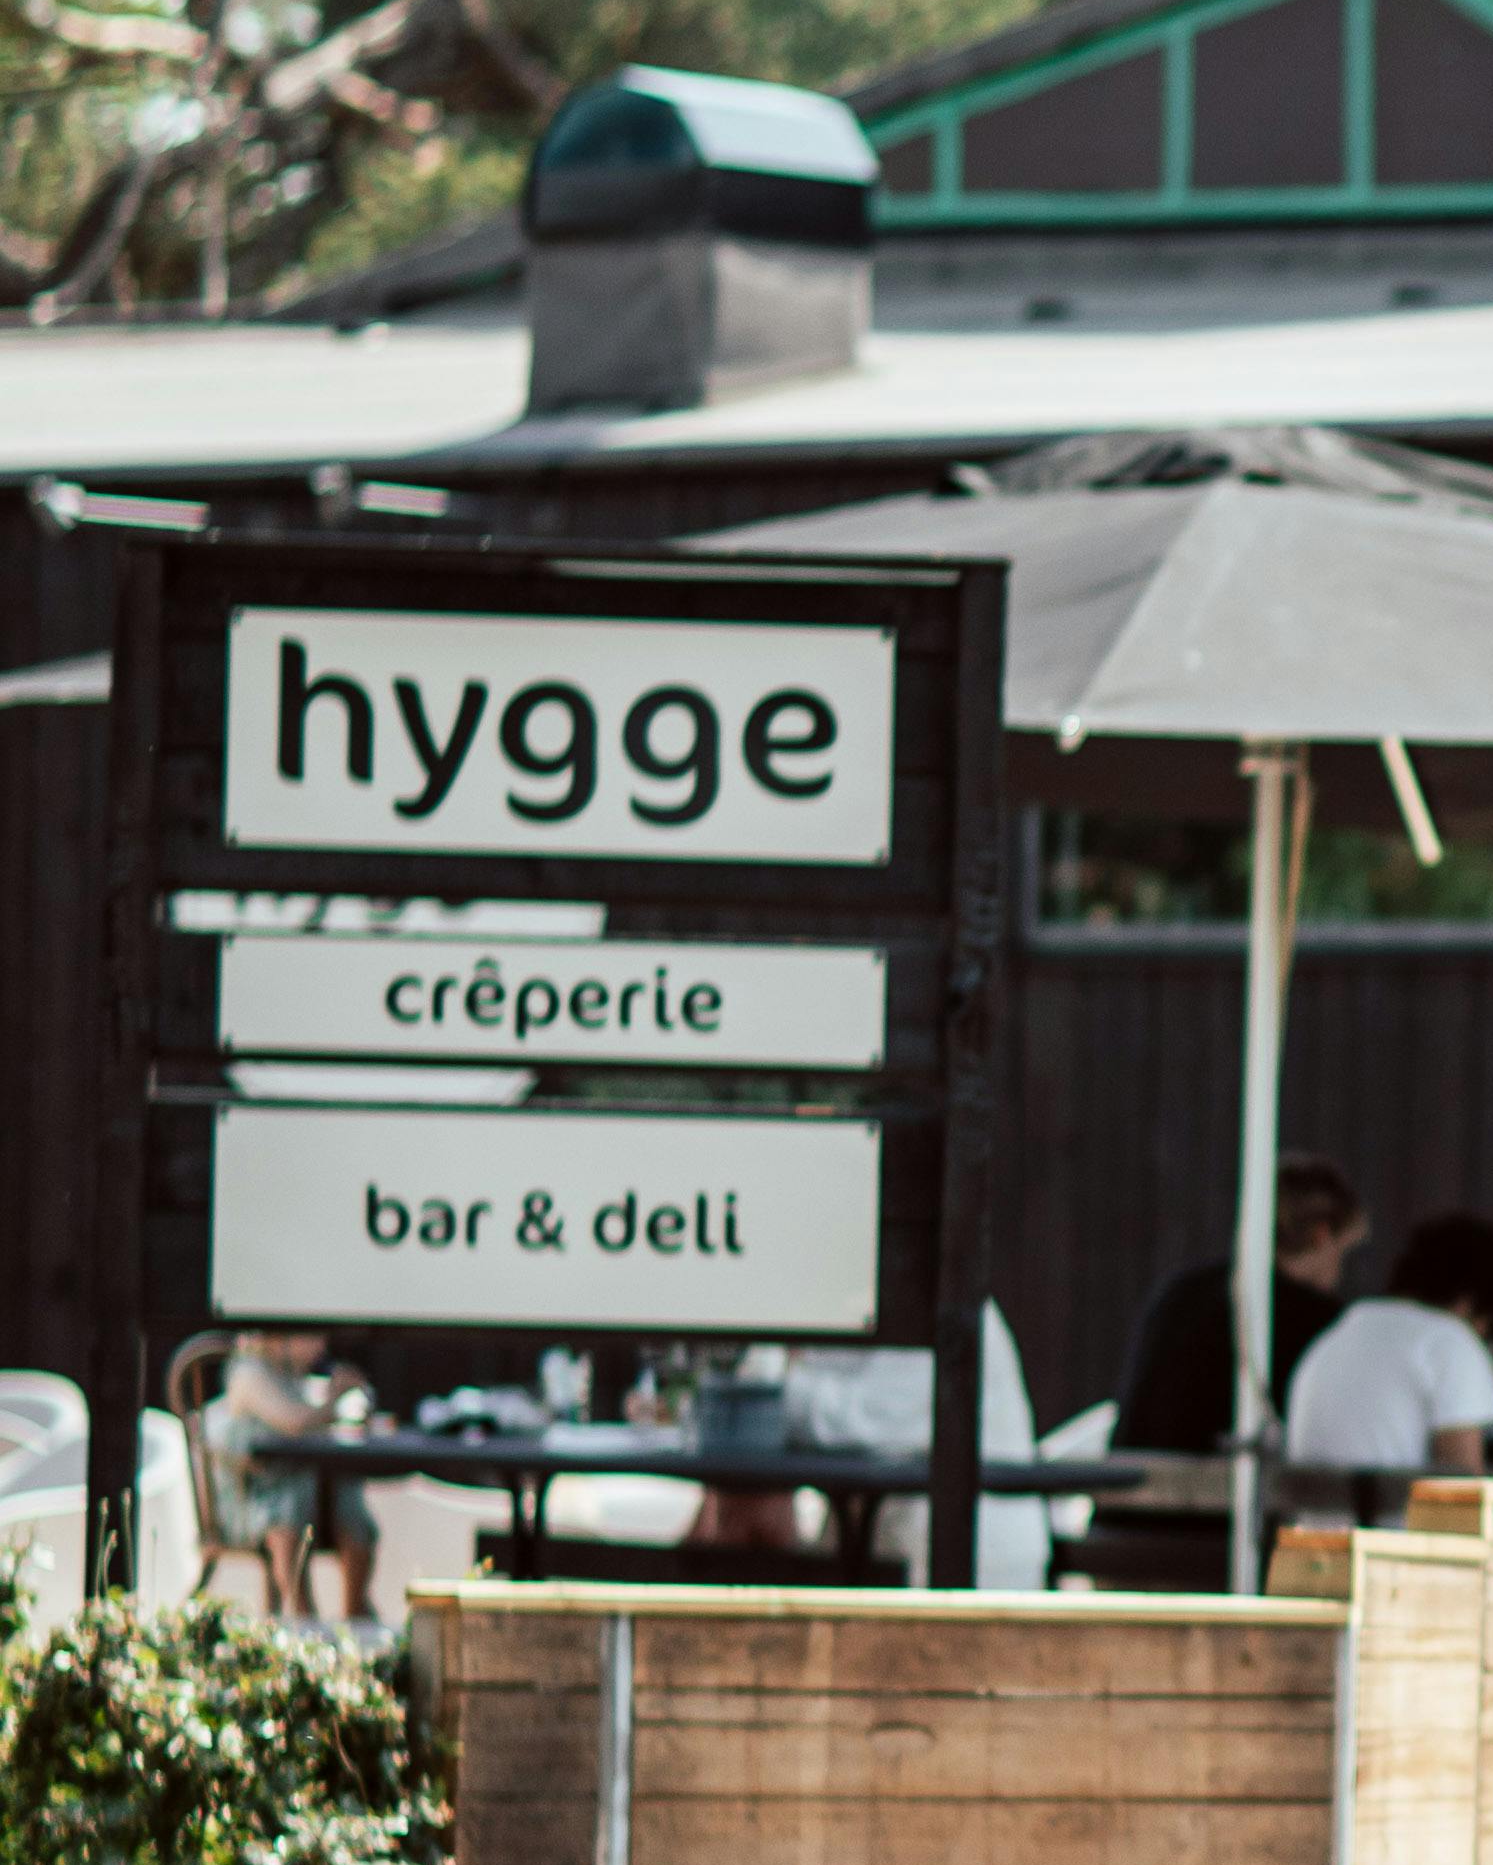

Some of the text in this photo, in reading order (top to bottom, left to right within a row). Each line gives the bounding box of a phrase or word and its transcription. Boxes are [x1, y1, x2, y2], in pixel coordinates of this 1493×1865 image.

[278, 635, 838, 827] hygge
[384, 956, 723, 1040] crêperie
[365, 1182, 744, 1255] bar & deli
